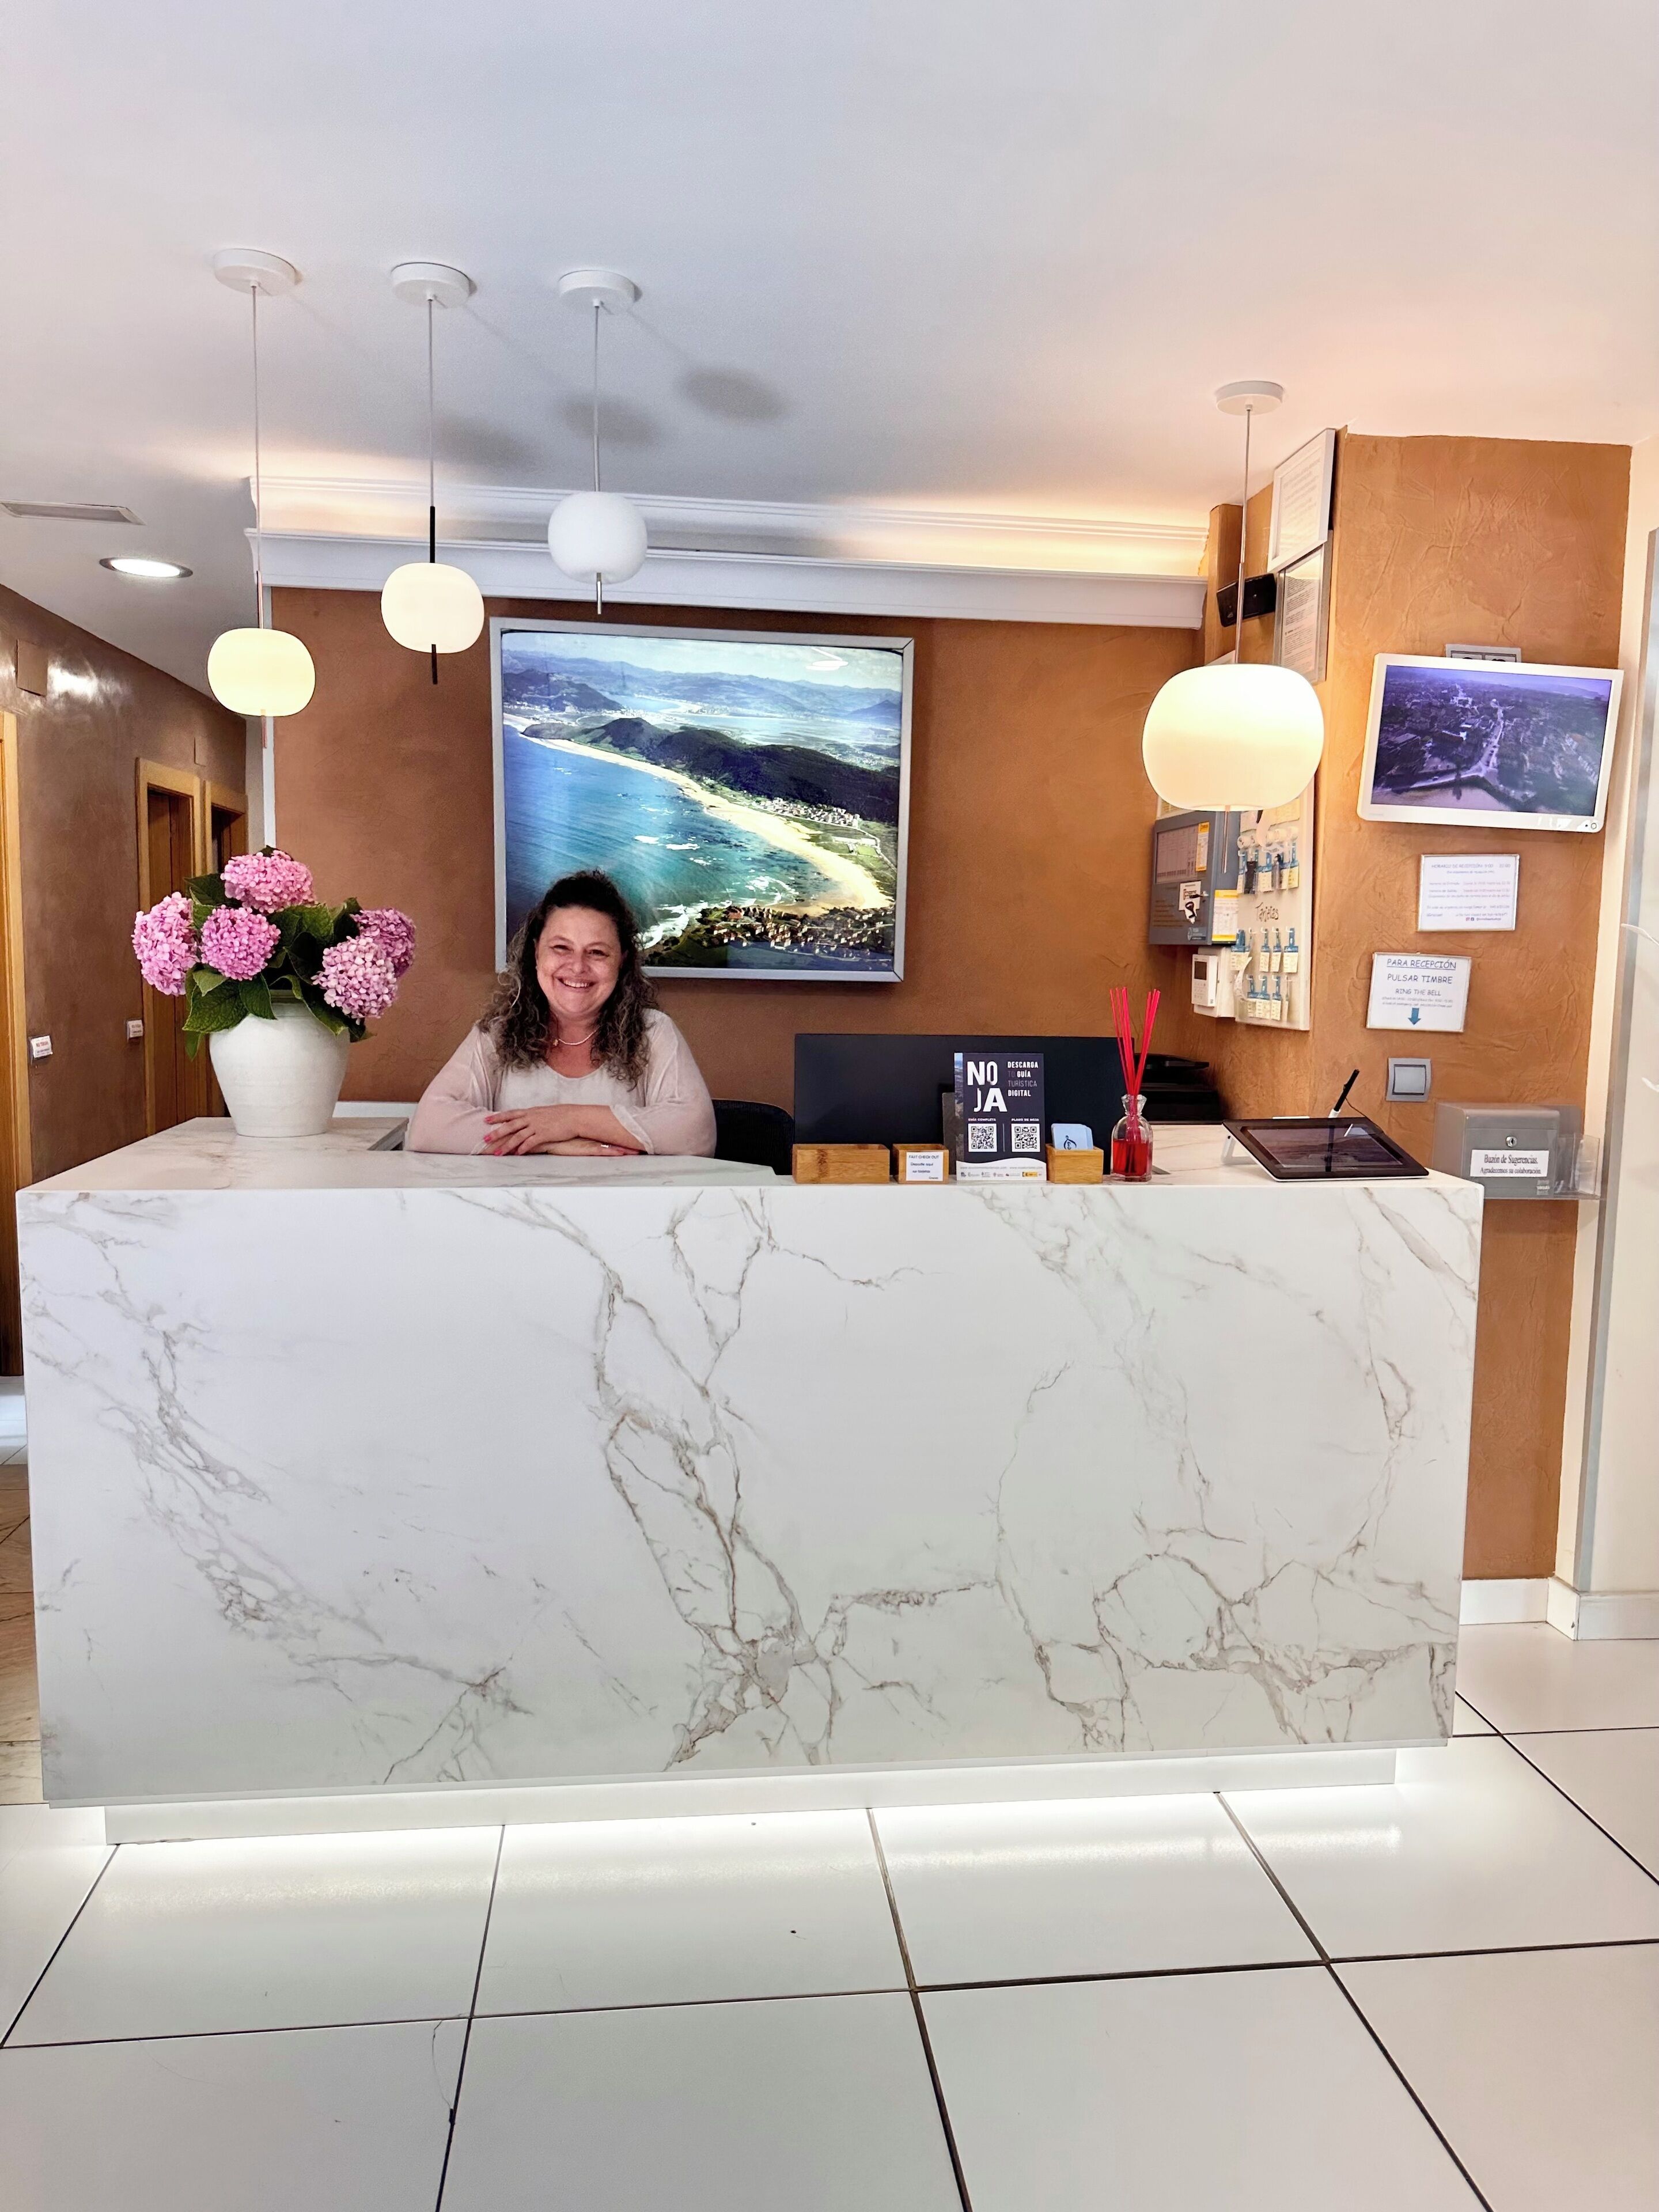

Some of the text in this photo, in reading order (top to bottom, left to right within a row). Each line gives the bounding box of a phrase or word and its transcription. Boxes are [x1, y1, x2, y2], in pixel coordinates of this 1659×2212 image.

[1411, 959, 1456, 969] RECEPCIÓN
[1387, 974, 1453, 984] PULSAR TIMBRE
[967, 1061, 998, 1086] NO
[1017, 1070, 1031, 1078] GUÍA
[1008, 1080, 1037, 1088] TURÍSTICA
[974, 1088, 1007, 1112] JA
[1484, 1154, 1500, 1163] Buzón
[1501, 1154, 1507, 1163] de
